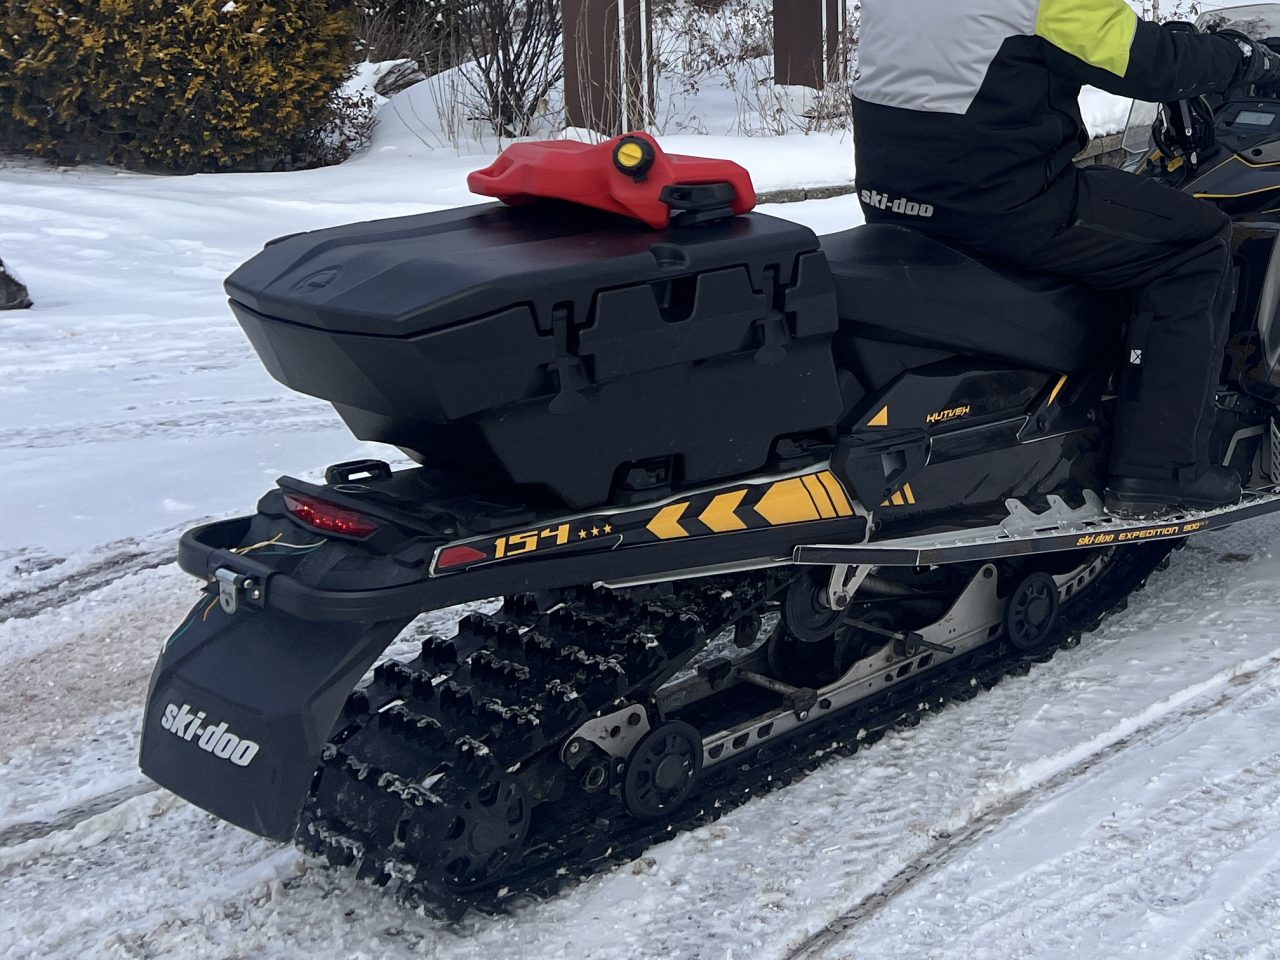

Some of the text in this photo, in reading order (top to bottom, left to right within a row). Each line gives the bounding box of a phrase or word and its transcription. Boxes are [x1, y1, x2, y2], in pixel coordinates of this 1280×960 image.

[861, 189, 934, 217] ski-doo
[494, 523, 570, 559] 154
[1076, 533, 1115, 546] ski-doo
[1118, 525, 1179, 541] EXPEDITION
[161, 703, 260, 767] ski-doo
